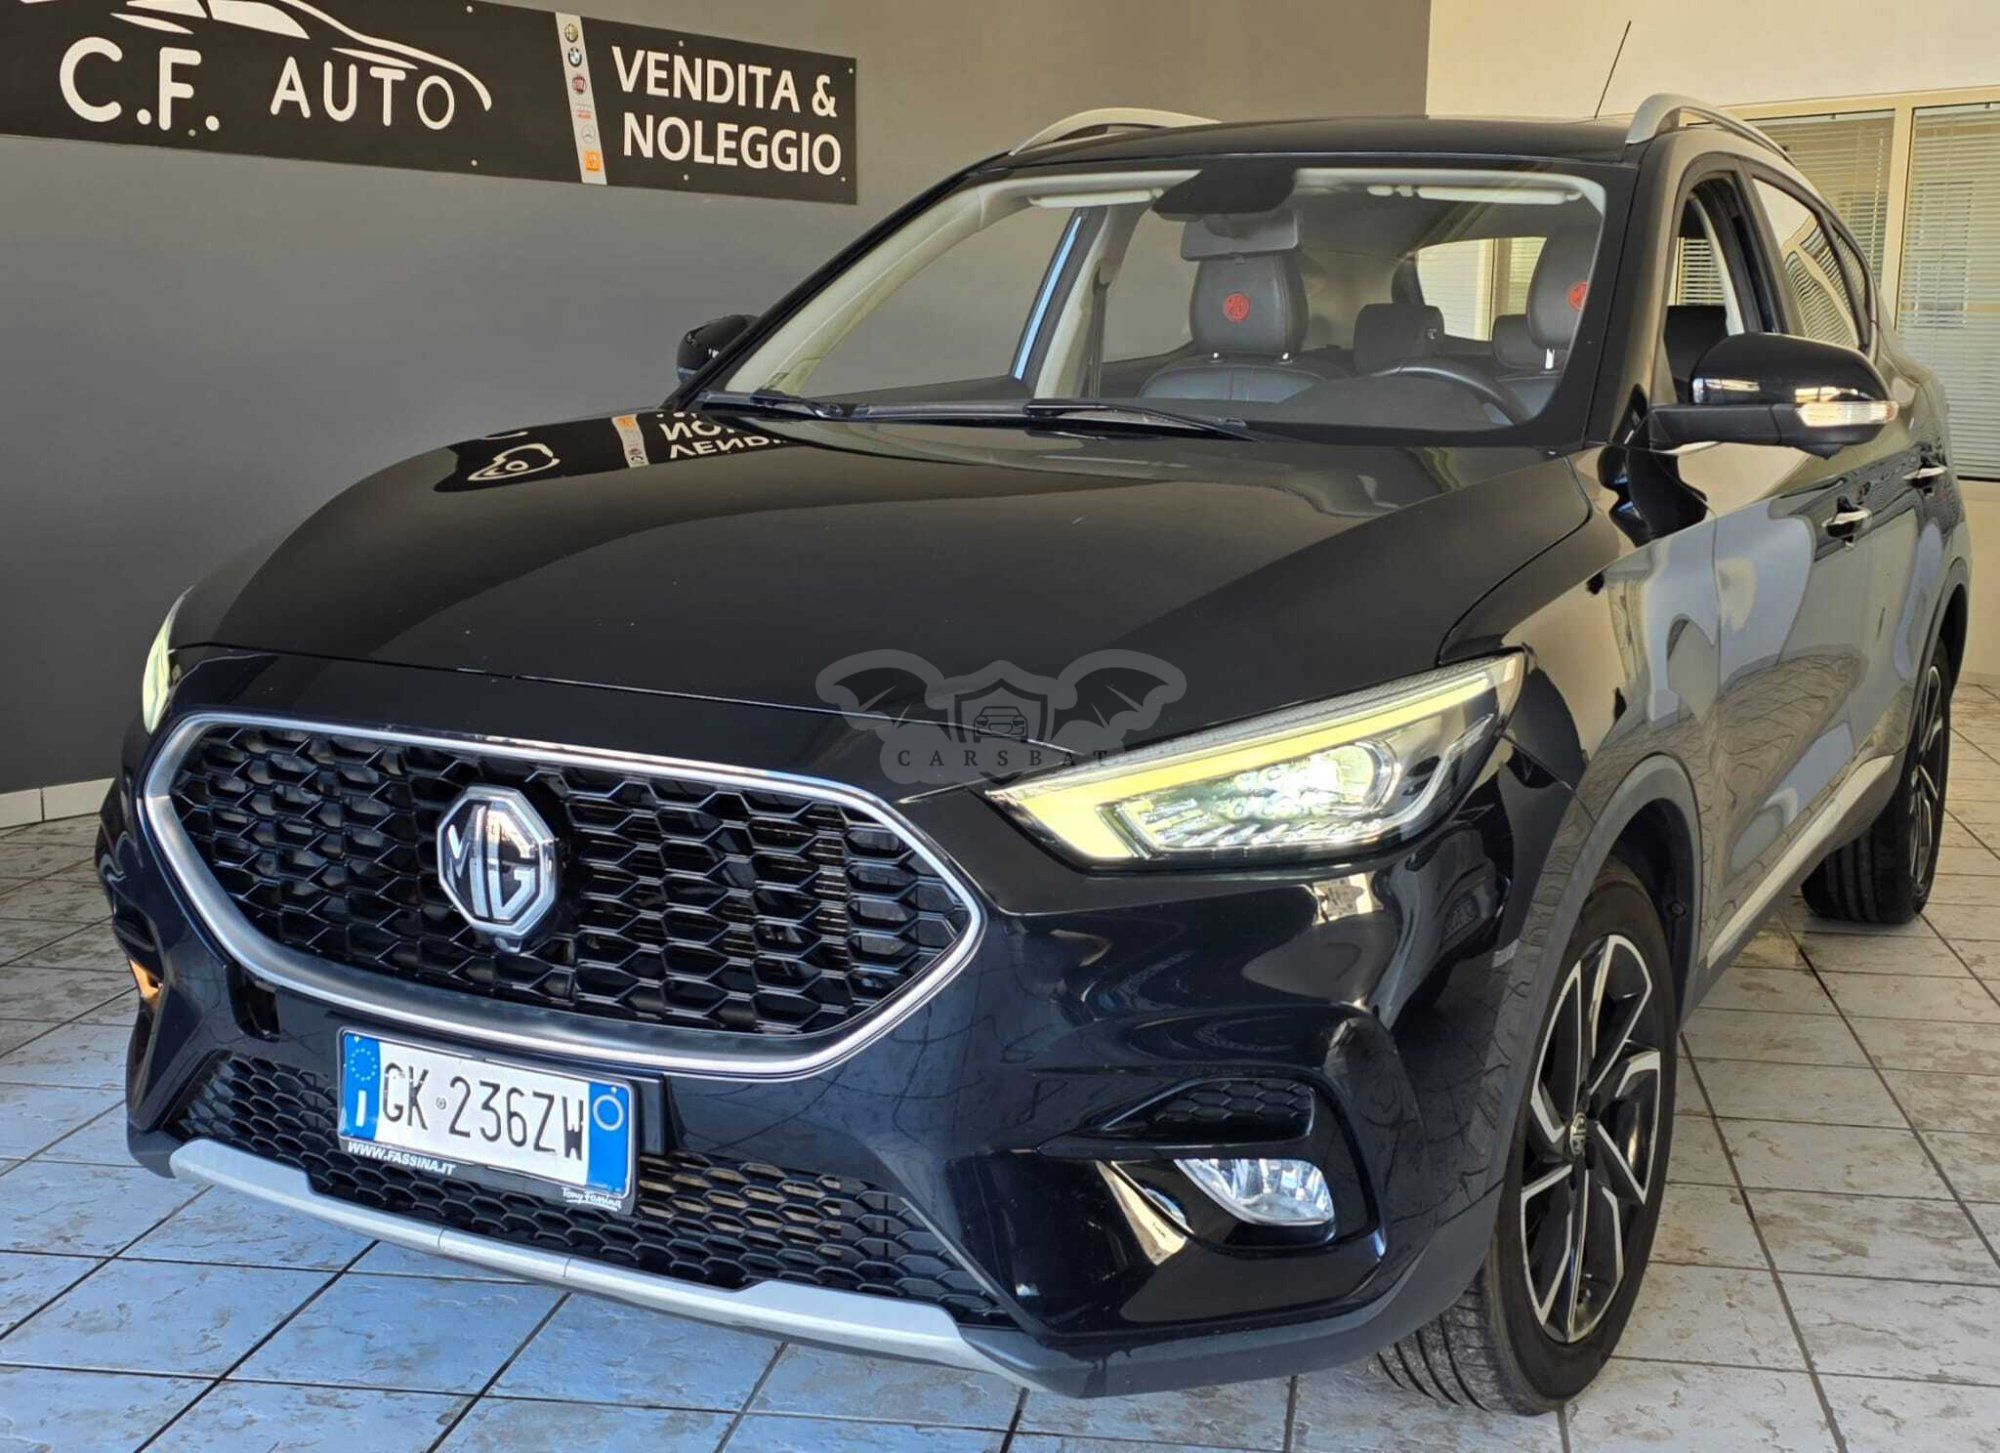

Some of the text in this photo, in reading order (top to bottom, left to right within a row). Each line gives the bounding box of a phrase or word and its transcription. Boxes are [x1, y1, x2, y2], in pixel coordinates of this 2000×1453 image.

[59, 36, 456, 132] C.F. AUTO
[611, 46, 837, 118] VENDITA &
[622, 112, 842, 176] NOLEGGIO
[447, 804, 536, 920] MG
[355, 1090, 367, 1127] I
[382, 1062, 584, 1161] GK 236ZW
[347, 1141, 457, 1176] WWW.FASSINA.IT
